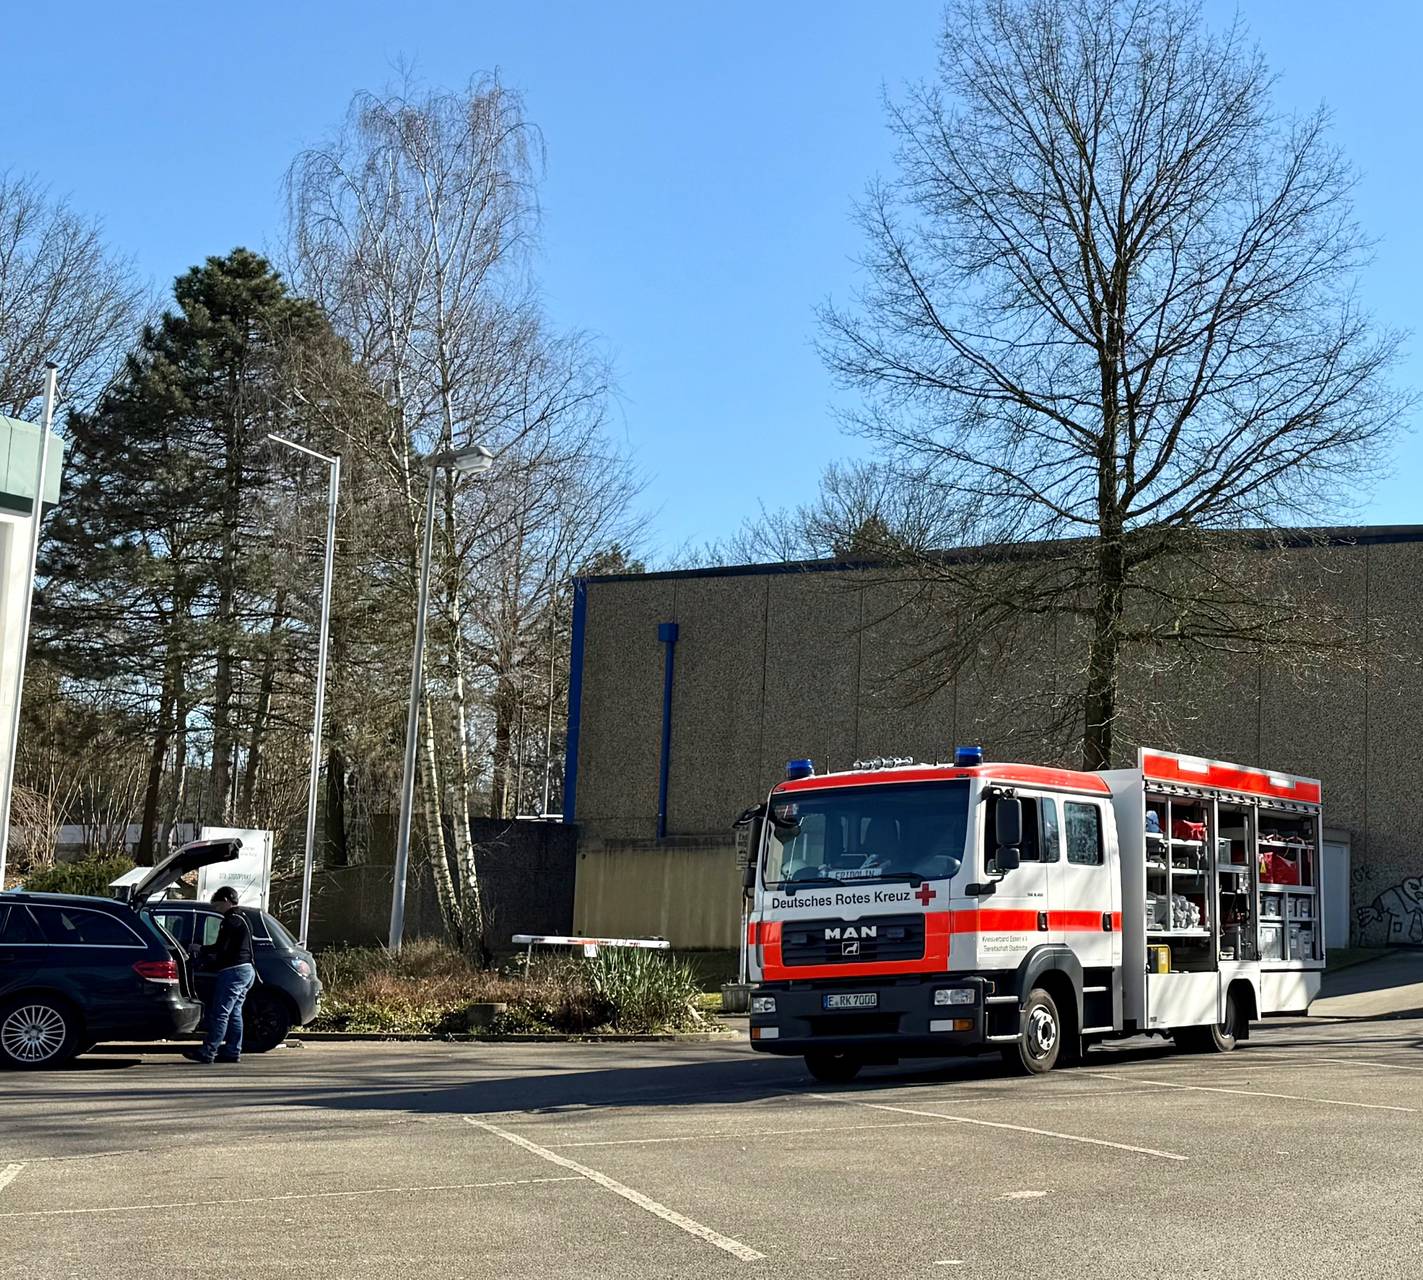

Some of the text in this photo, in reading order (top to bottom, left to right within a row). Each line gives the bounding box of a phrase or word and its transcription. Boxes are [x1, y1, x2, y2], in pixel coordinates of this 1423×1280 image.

[772, 891, 911, 909] Deutsches Rotes Kreuz
[825, 926, 877, 940] MAN
[829, 994, 876, 1006] E RK 7000
